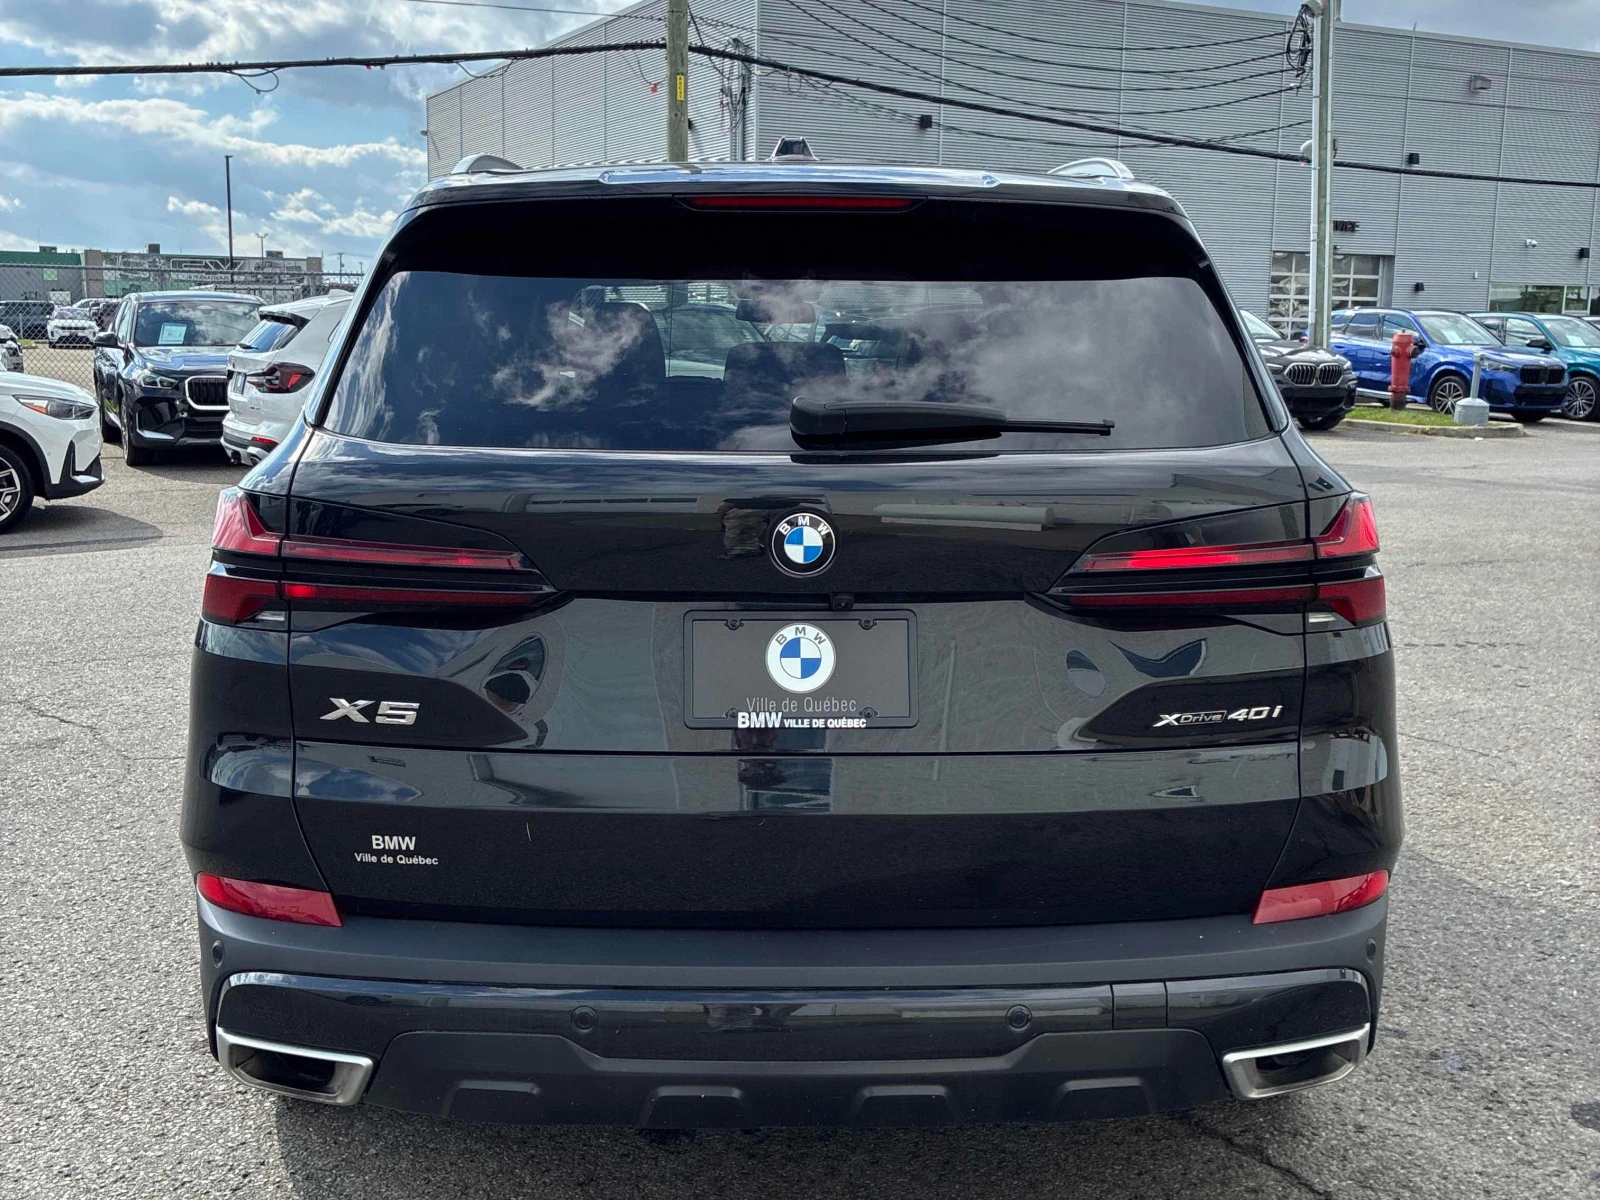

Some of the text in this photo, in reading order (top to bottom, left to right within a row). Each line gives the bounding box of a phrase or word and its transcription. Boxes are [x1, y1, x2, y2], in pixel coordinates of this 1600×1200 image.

[779, 515, 830, 536] BMW
[775, 626, 827, 646] BMW
[319, 697, 421, 726] X5
[746, 696, 857, 713] Ville de Québec
[737, 711, 868, 729] BMW VILLE DE QUÉBEC
[371, 834, 417, 851] BMW
[354, 852, 439, 866] Ville de Québec
